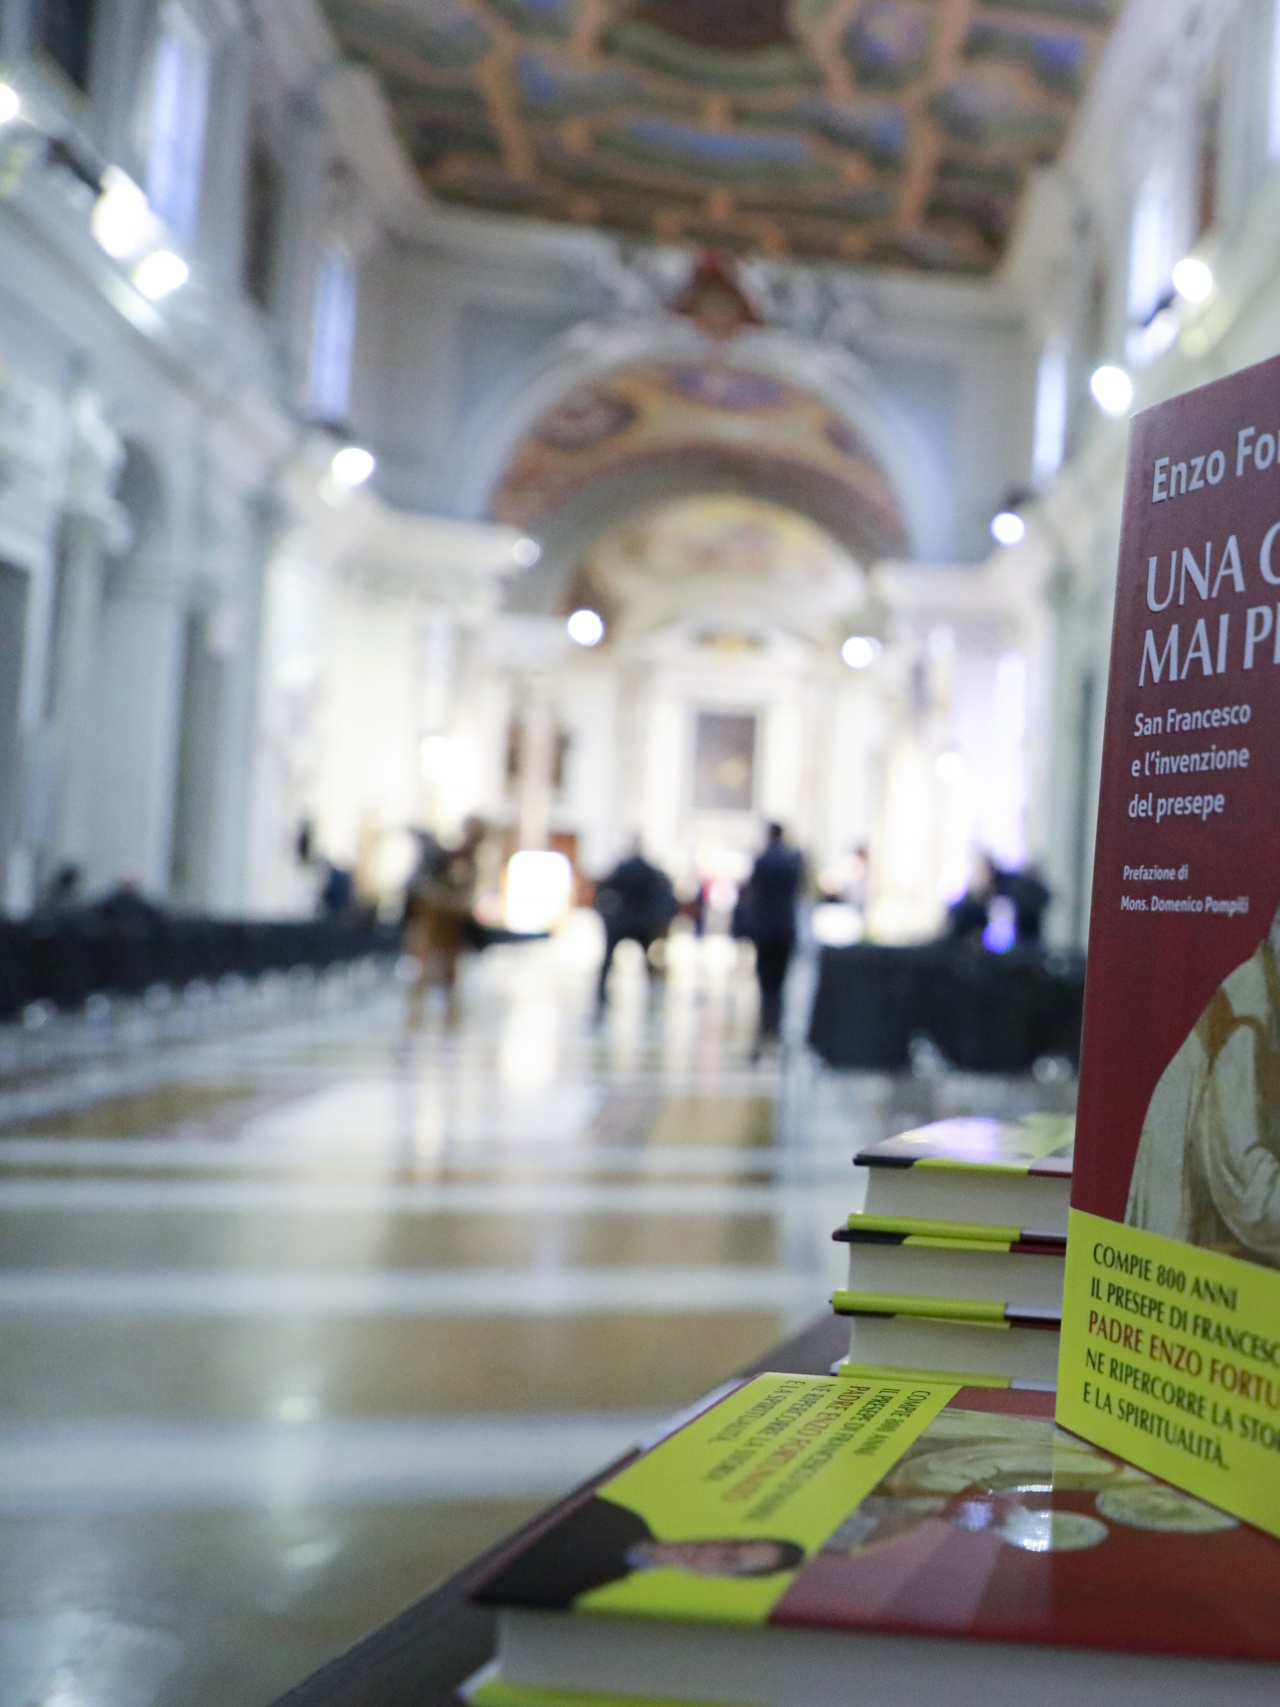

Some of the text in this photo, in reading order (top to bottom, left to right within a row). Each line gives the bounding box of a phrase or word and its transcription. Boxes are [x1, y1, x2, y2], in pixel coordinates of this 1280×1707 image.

[1152, 449, 1226, 503] Enzo
[1146, 535, 1245, 612] UNA
[1138, 613, 1230, 687] MAI
[1133, 704, 1251, 737] San Francesco
[1131, 745, 1250, 777] e l'invenzione
[1128, 792, 1225, 823] del presepe
[1123, 864, 1189, 880] Prefazione di
[1120, 895, 1250, 917] Mons. Domenico Pompili
[1093, 1243, 1238, 1311] COMPIE 800 ANNI
[1090, 1277, 1102, 1300] IL
[1106, 1282, 1165, 1324] PRESEPE
[1169, 1305, 1188, 1332] DI
[1088, 1310, 1143, 1353] PADRE
[1149, 1334, 1203, 1377] ENZO
[825, 1385, 870, 1410] PADRE
[890, 1390, 931, 1417] COMPIE
[1085, 1348, 1105, 1374] NE
[1109, 1358, 1206, 1419] RIPERCORRE
[1211, 1402, 1233, 1432] LA
[796, 1412, 841, 1435] ENZO
[850, 1394, 892, 1421] PRESEPE
[1083, 1382, 1230, 1471] E LA SPIRITUALITÀ.
